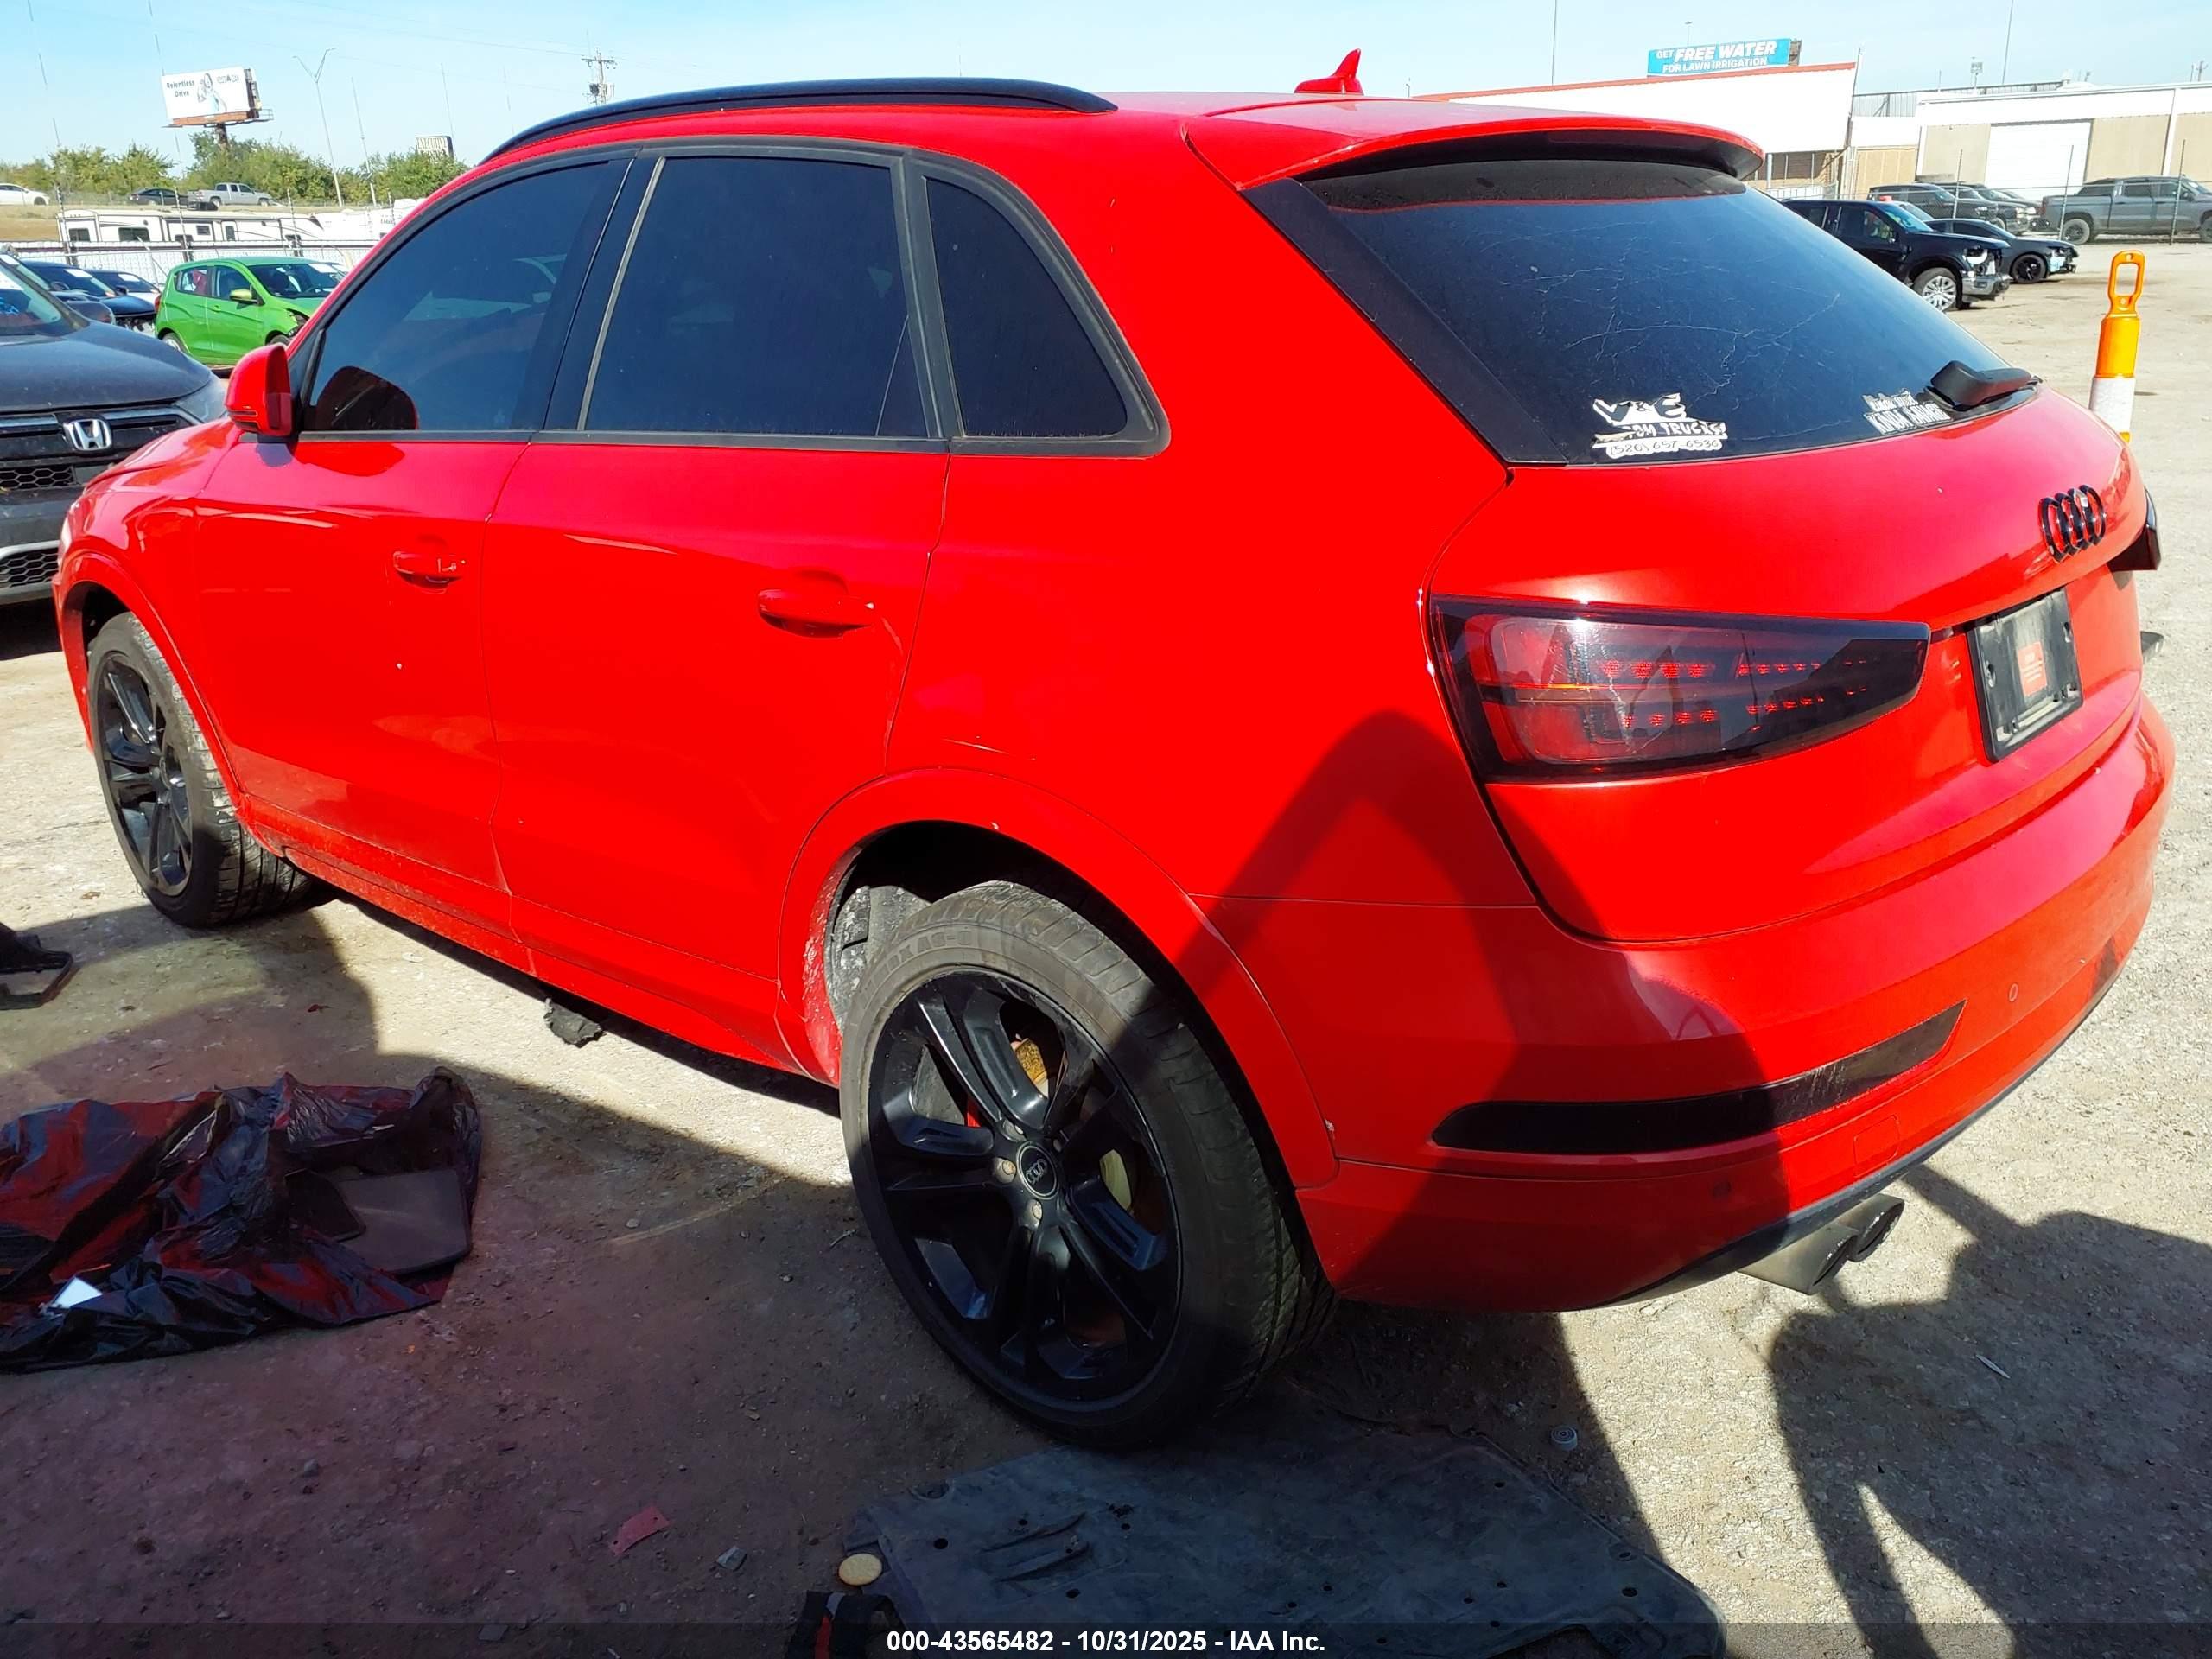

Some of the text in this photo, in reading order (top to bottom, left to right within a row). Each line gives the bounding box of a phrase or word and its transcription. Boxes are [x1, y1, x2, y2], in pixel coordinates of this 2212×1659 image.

[1656, 41, 1777, 62] GET FREE WATER
[1662, 57, 1768, 73] FOR LAWN IRRIGATION
[167, 80, 194, 89] Relentless
